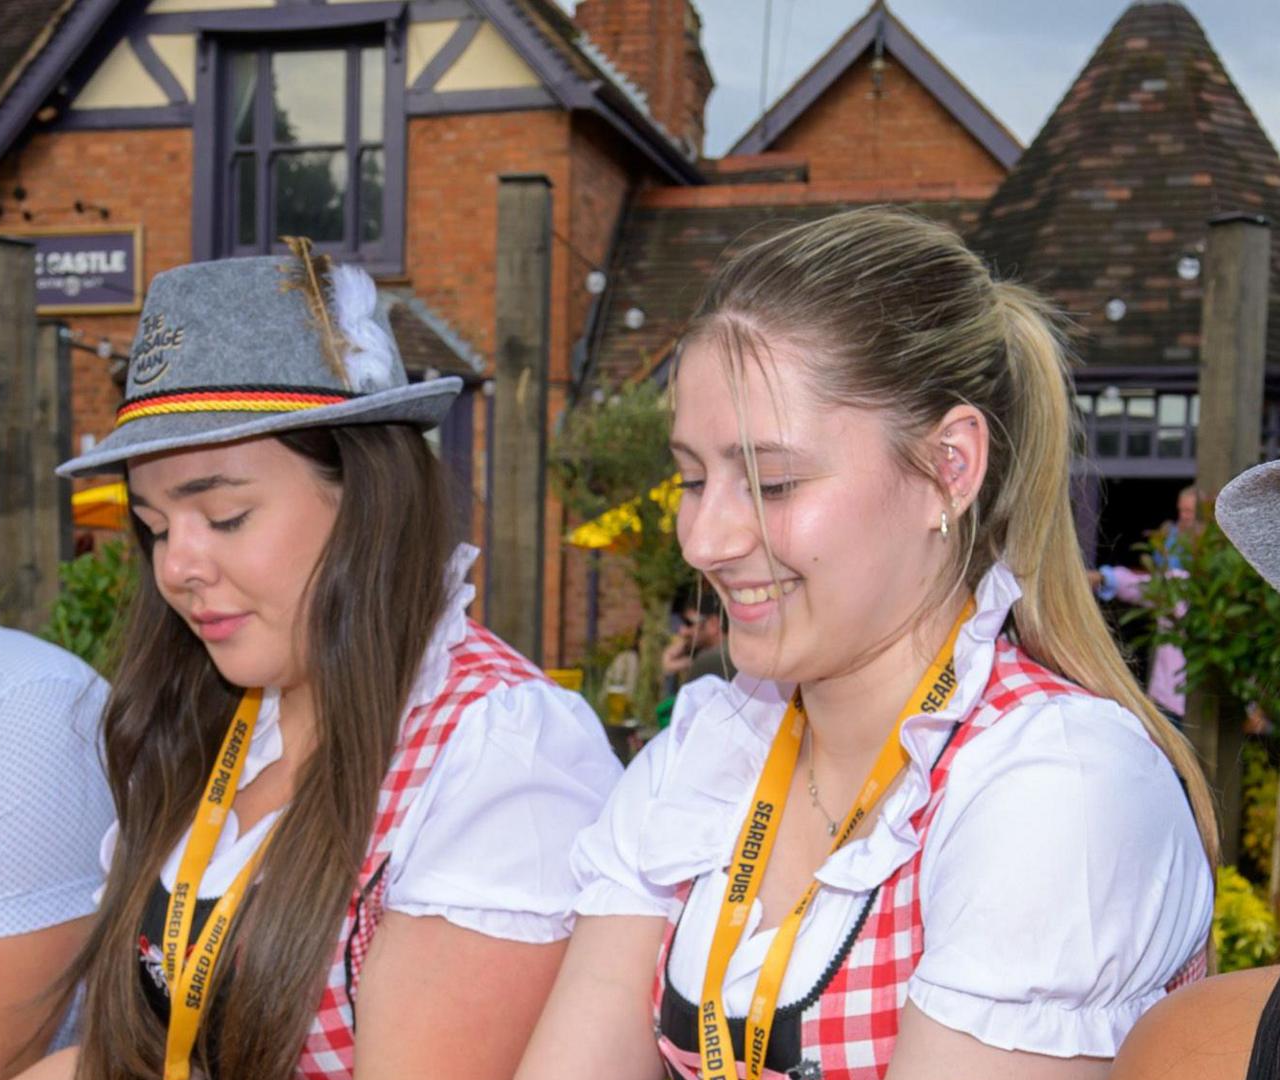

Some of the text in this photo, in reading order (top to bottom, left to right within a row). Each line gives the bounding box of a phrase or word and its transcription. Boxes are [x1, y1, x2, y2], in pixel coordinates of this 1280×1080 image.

[46, 250, 126, 275] CASTLE
[143, 313, 165, 337] THE
[136, 352, 164, 375] MAN
[222, 719, 248, 769] SEARED
[207, 768, 232, 805] PUBS
[742, 801, 774, 861] SEARED
[728, 863, 755, 903] PUBS
[168, 882, 190, 939] SEARED
[185, 955, 211, 1011] SEARED
[204, 914, 227, 954] PUBS
[703, 1000, 724, 1071] SEARED
[751, 1026, 766, 1077] PUBS
